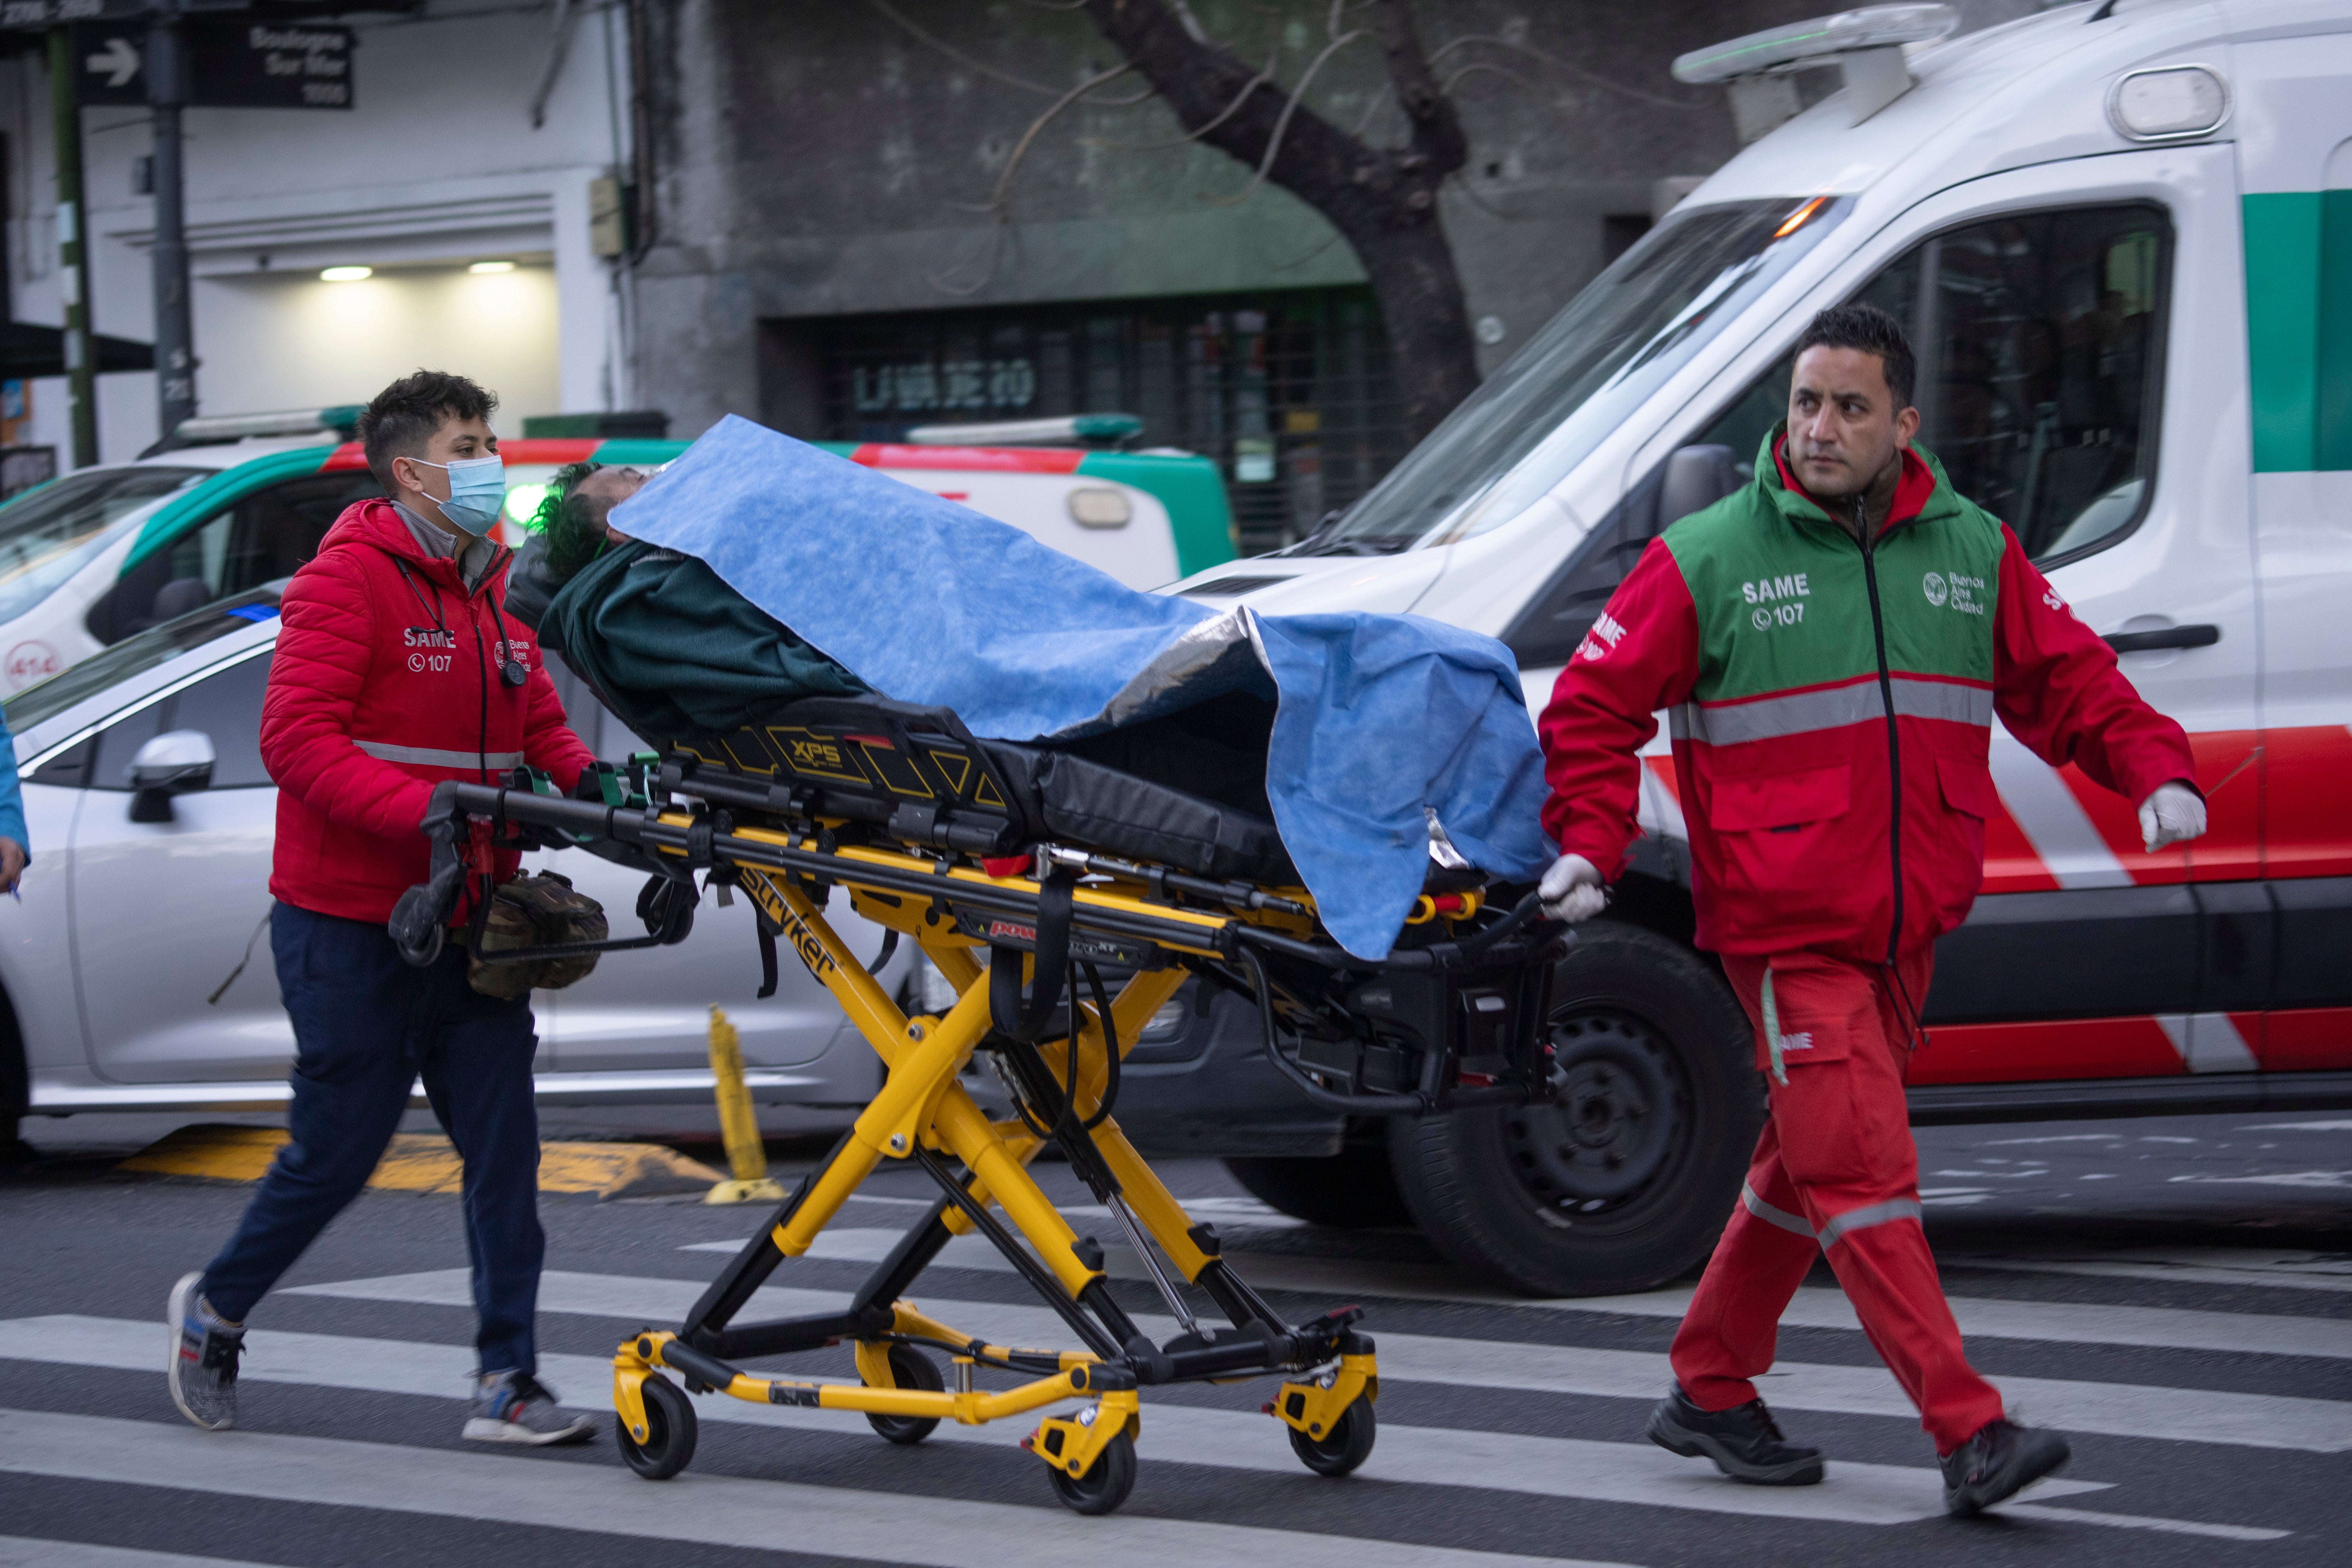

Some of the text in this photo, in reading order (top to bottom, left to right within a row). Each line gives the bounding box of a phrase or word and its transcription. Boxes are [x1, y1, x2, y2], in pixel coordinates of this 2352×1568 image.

[1742, 573, 1810, 604] SAME
[1949, 571, 1984, 589] Buenos
[1773, 602, 1804, 627] 107
[1951, 595, 1983, 616] Ciudad
[509, 639, 530, 650] Buenos
[513, 649, 527, 660] Aires
[428, 655, 452, 672] 107
[790, 739, 841, 767] XPS
[740, 865, 836, 974] stryker
